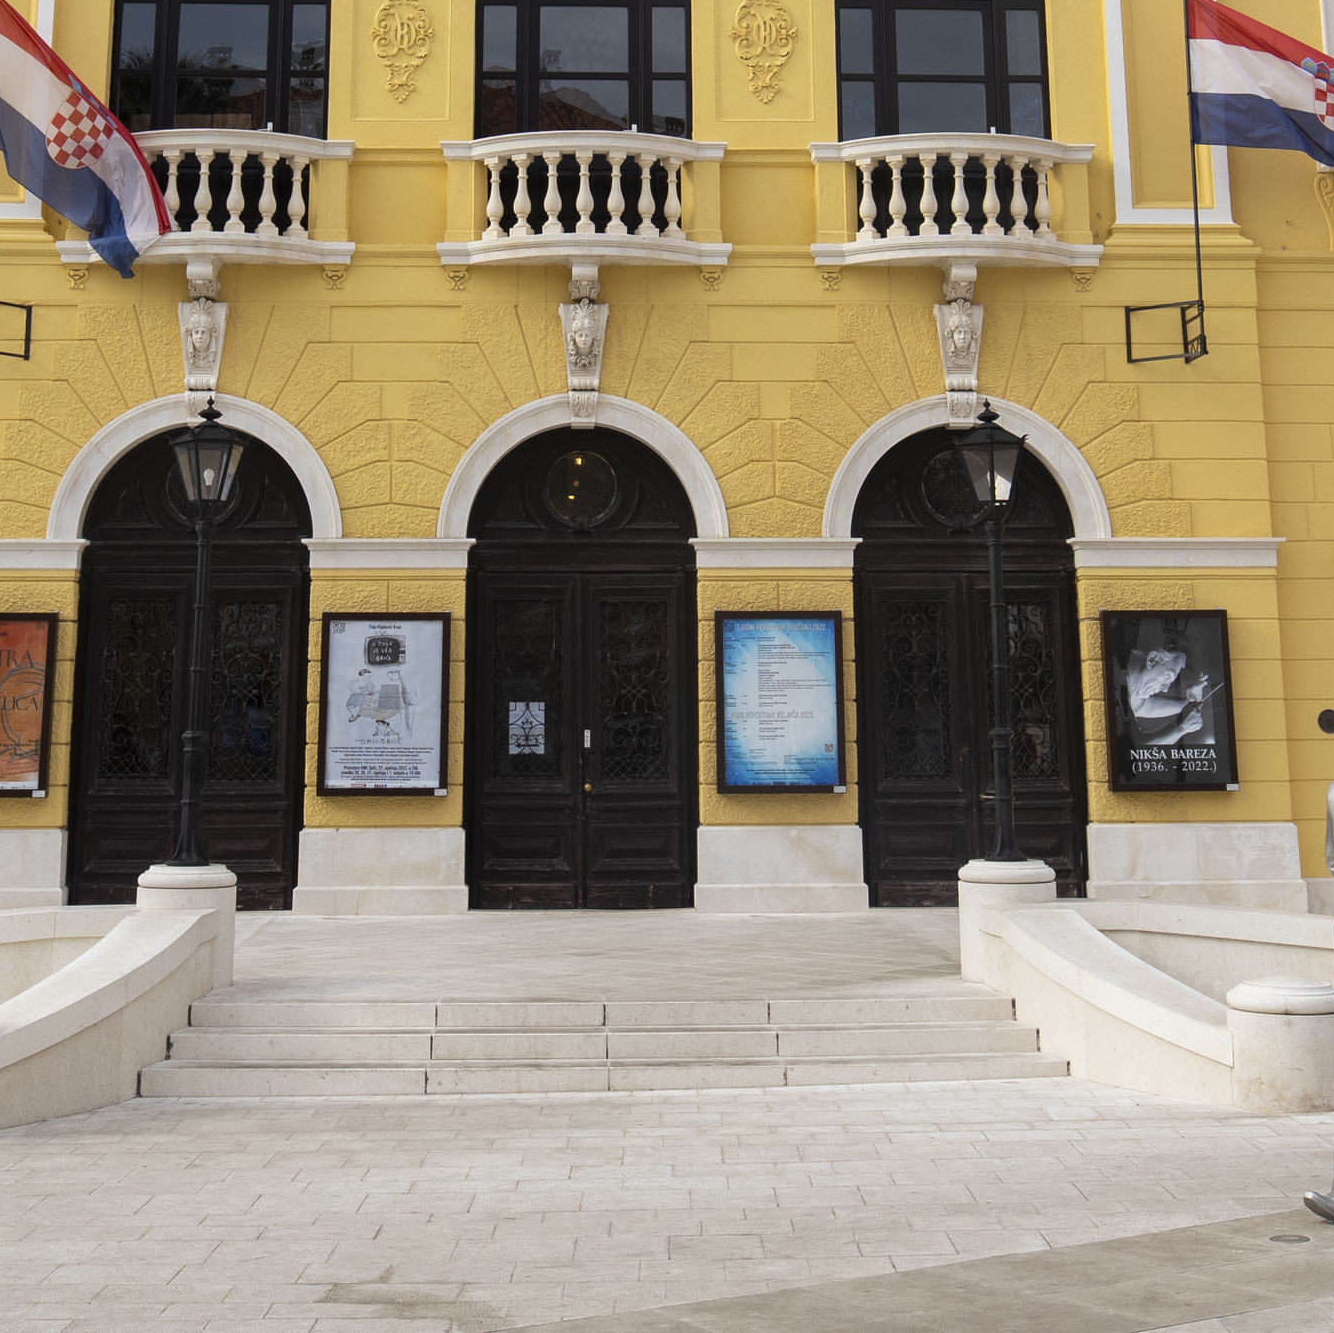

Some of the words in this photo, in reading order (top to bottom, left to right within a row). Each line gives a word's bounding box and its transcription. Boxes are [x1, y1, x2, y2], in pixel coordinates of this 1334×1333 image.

[1130, 747, 1167, 759] NIKŠA
[1170, 749, 1217, 759] BAREZA
[1132, 762, 1168, 774] (1936.
[1181, 760, 1217, 774] 2022.)
